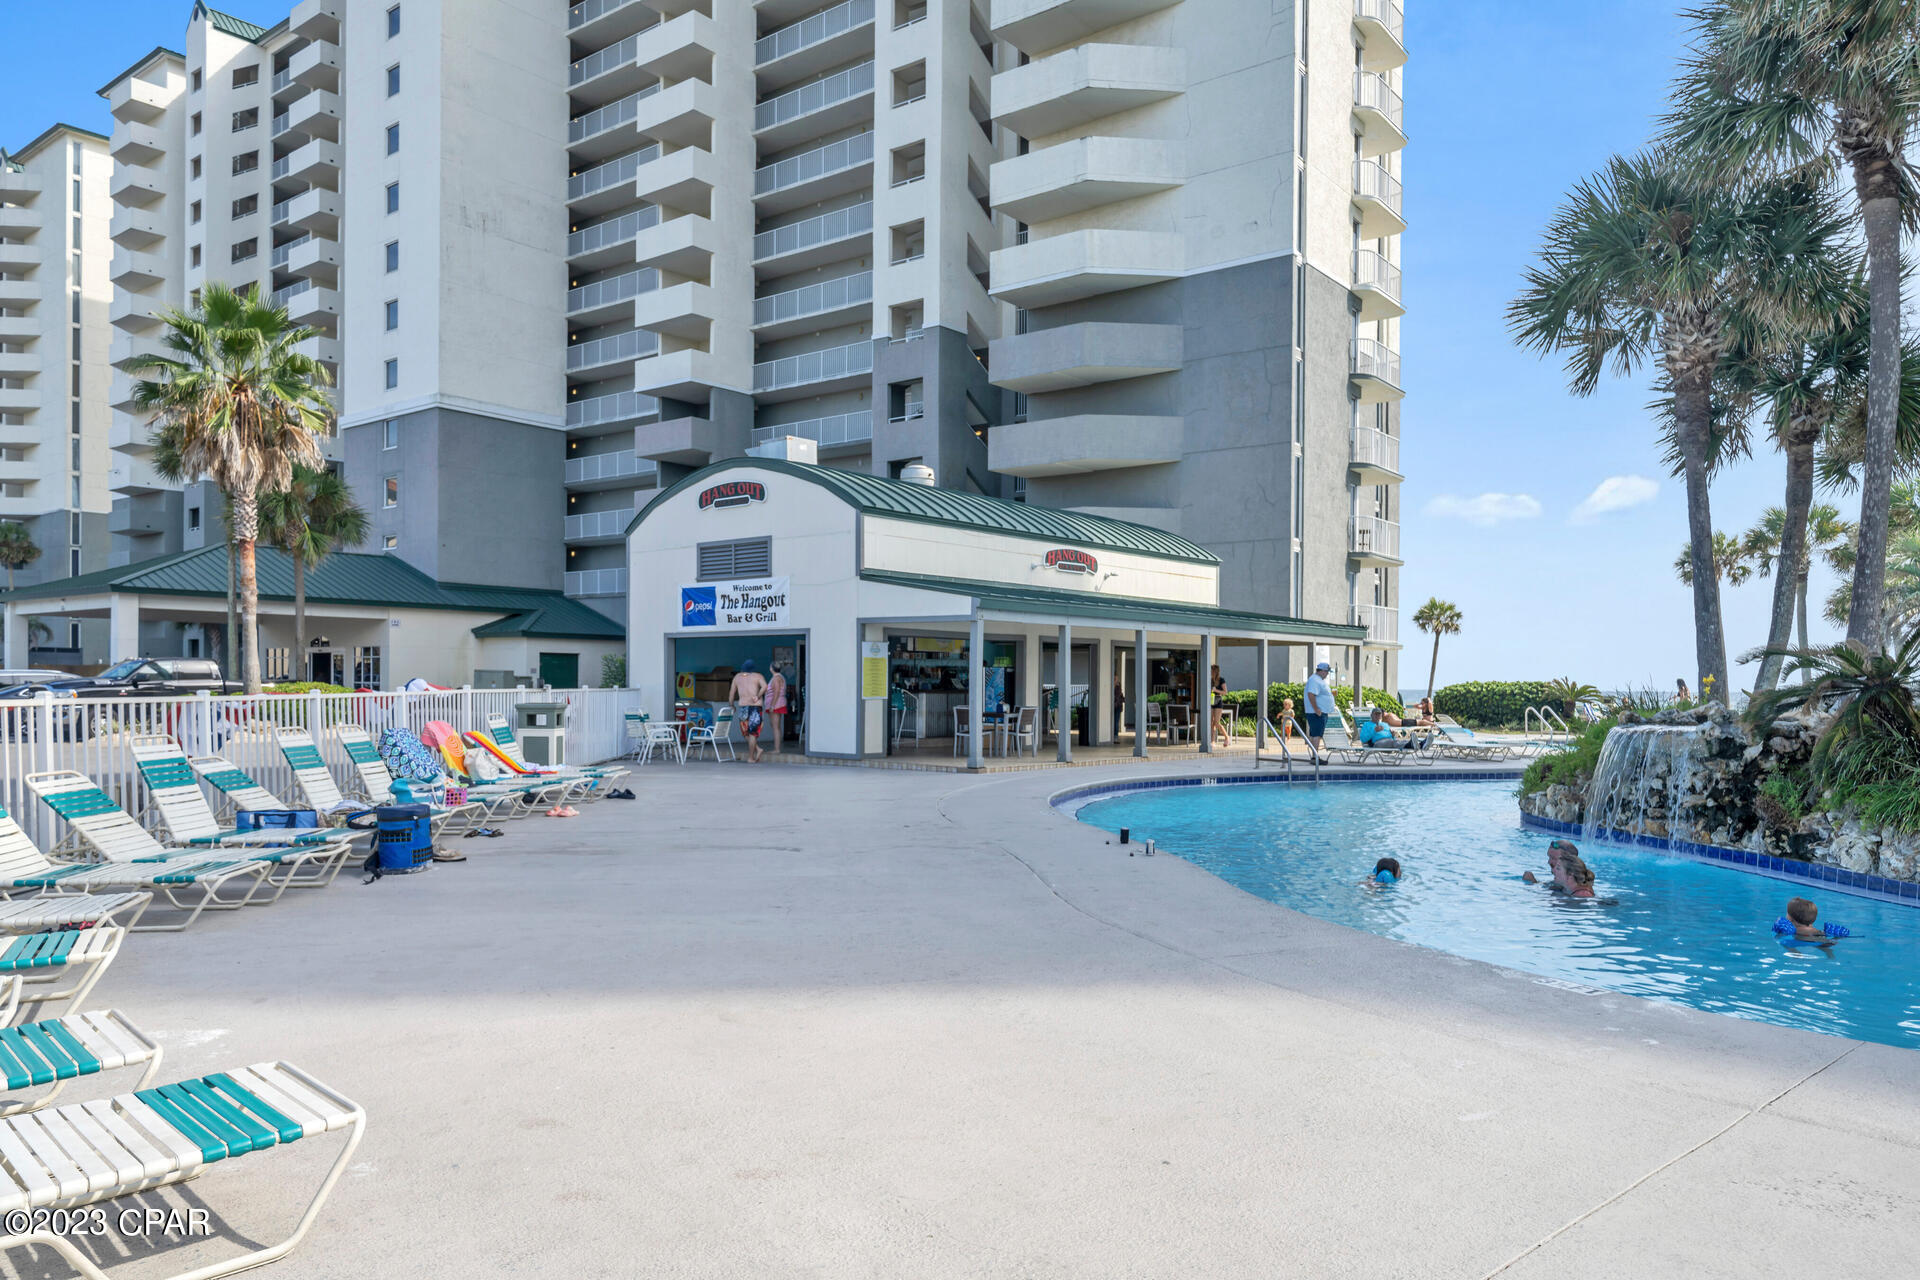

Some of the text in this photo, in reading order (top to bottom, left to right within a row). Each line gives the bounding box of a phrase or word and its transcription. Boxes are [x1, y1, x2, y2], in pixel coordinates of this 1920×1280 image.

[702, 483, 735, 506] HANG
[737, 482, 762, 500] OUT
[1047, 549, 1076, 566] HANG
[1076, 551, 1097, 571] OUT
[732, 584, 763, 592] Welcome
[694, 601, 713, 613] pepsi
[720, 593, 786, 612] The Hangout
[727, 612, 777, 623] Bar & Grill
